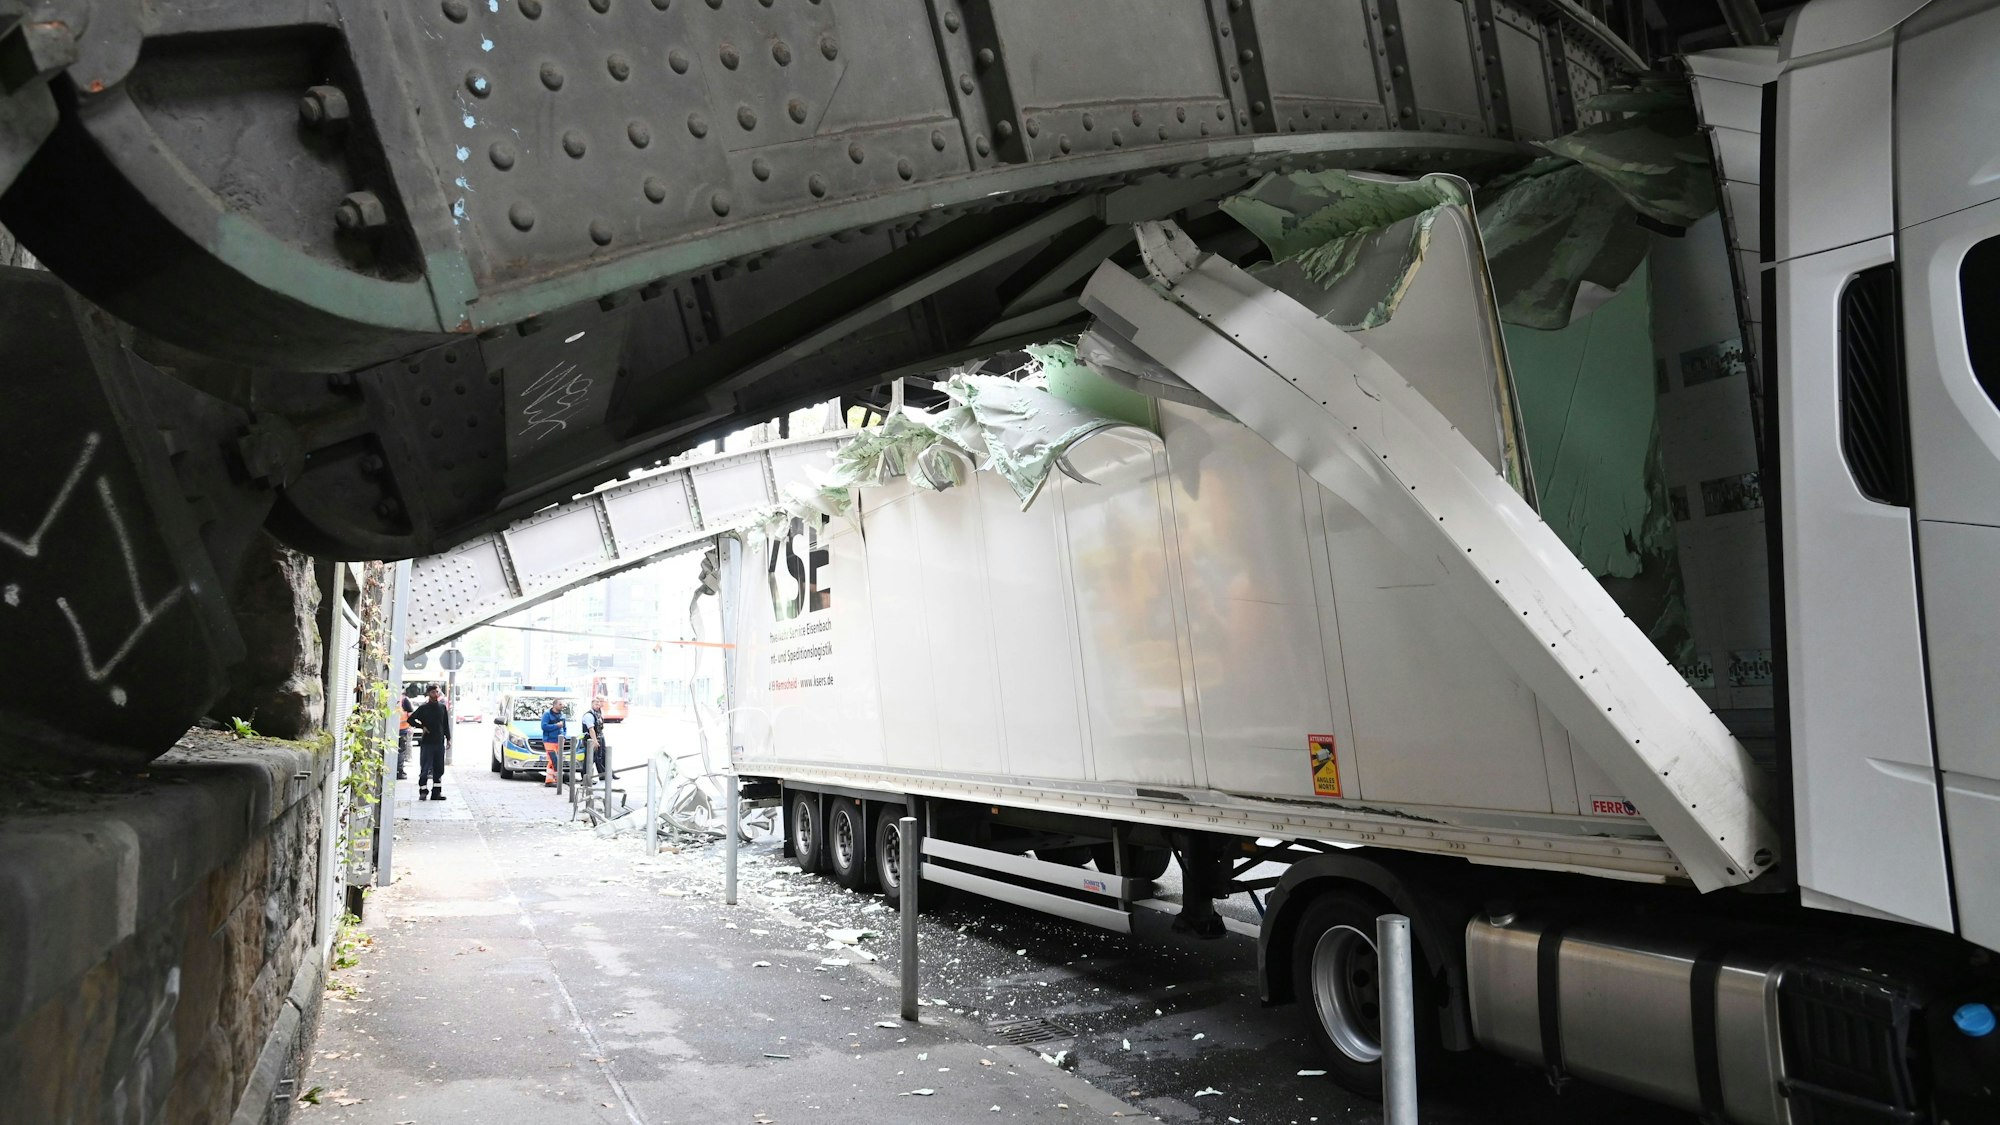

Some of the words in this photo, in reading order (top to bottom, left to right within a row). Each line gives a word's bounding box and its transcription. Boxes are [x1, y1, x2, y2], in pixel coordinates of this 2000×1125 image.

[806, 617, 832, 635] Eisenbach
[778, 649, 787, 663] und
[787, 640, 833, 664] Speditionslogistik
[776, 676, 798, 691] Remscheid
[800, 672, 834, 688] www.ksers.de
[1317, 776, 1335, 784] ANGLES
[1319, 783, 1335, 791] MORTS
